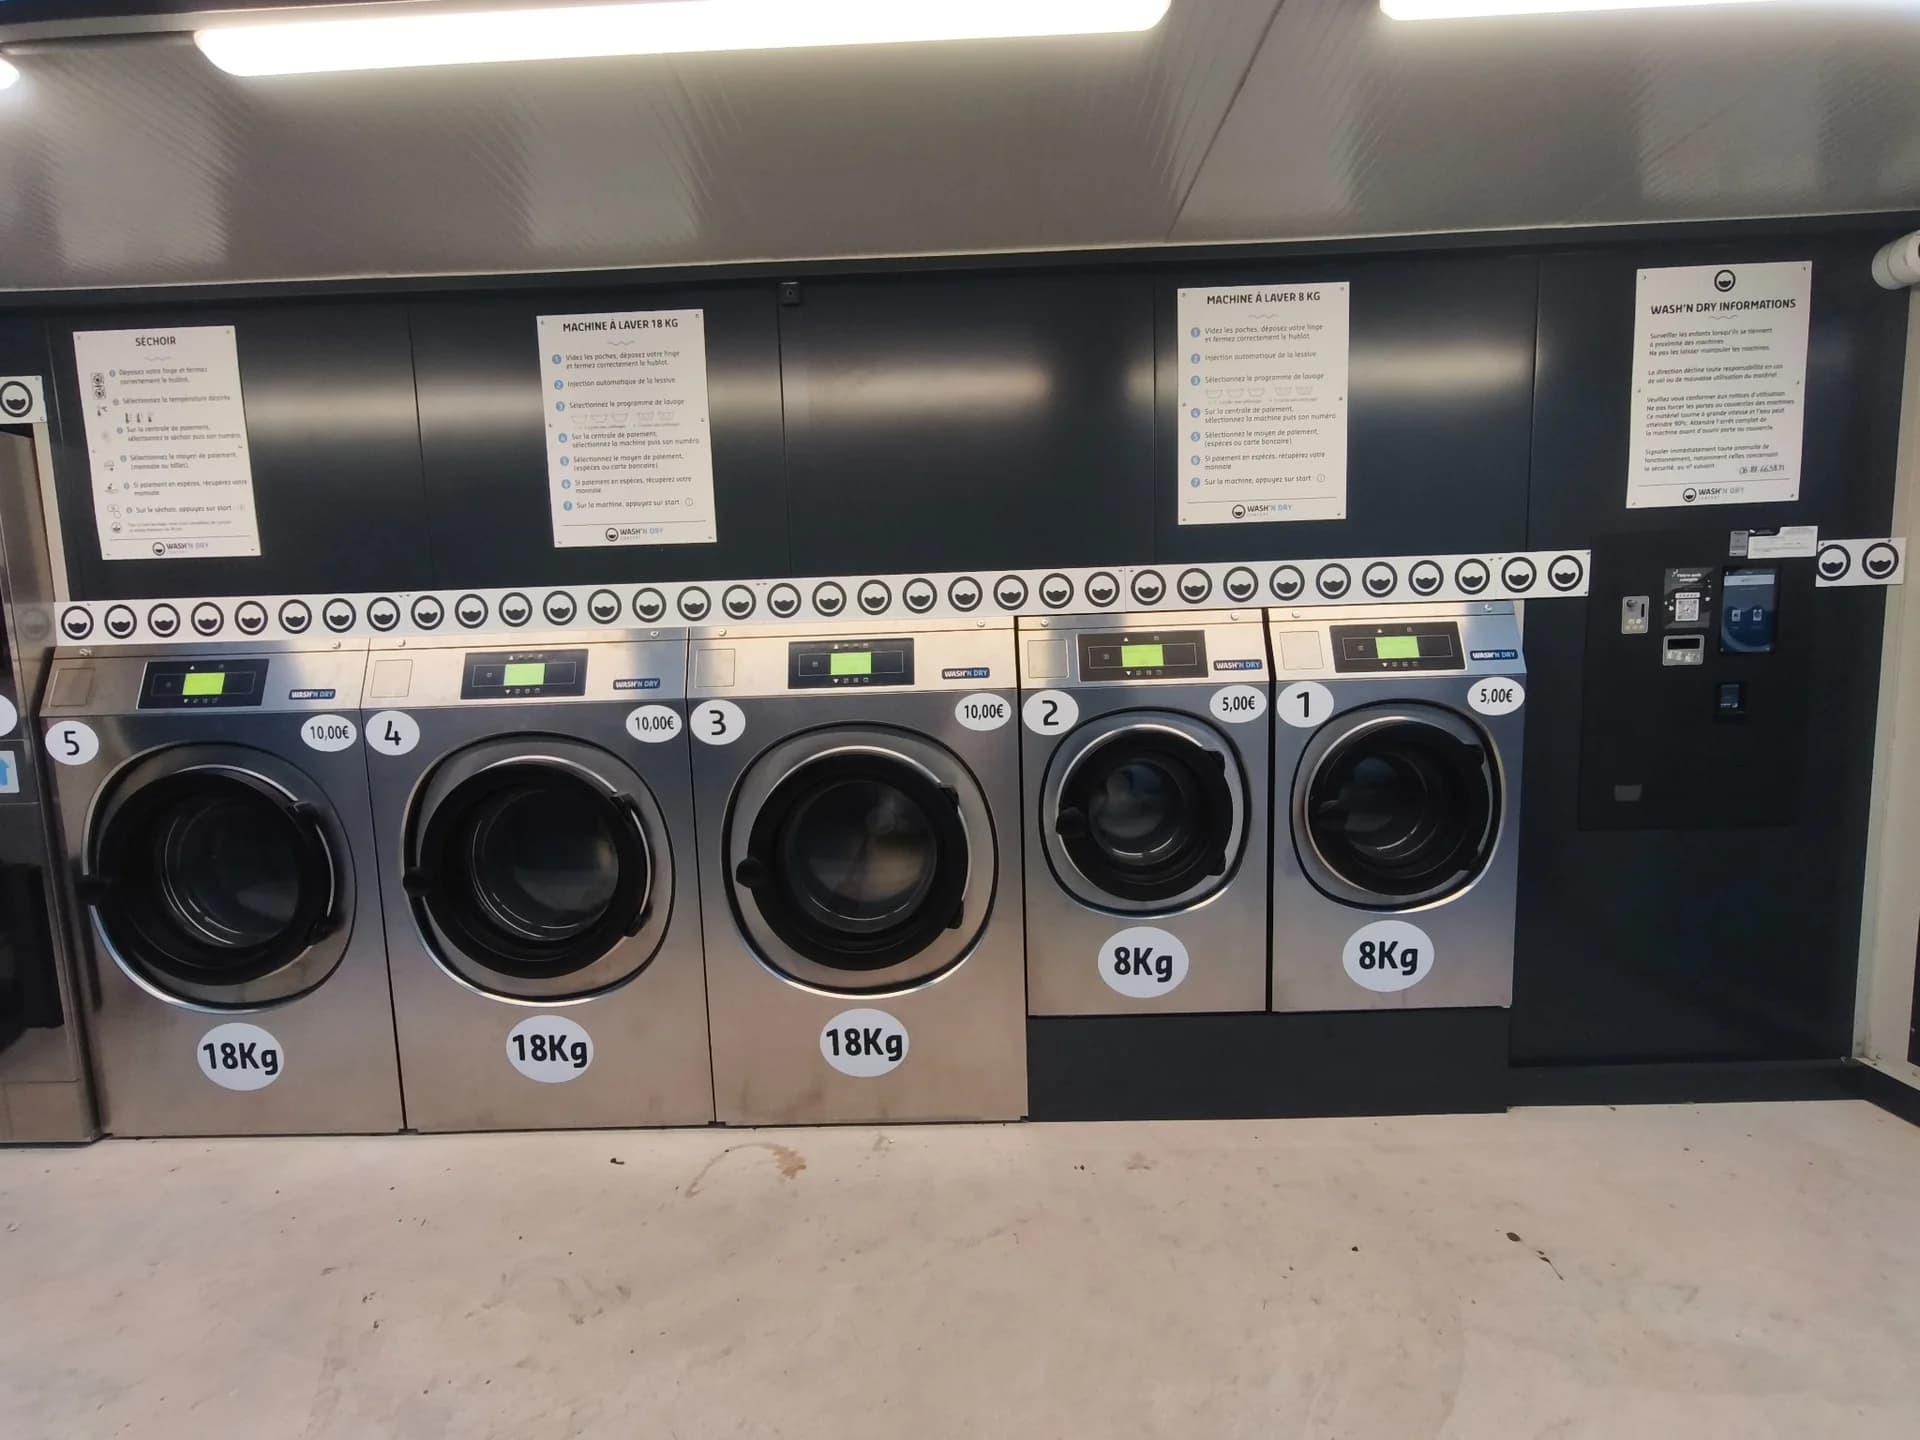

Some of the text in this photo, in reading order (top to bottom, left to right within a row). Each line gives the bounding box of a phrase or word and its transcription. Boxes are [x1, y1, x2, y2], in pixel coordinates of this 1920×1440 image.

[1206, 293, 1252, 305] MACHINE
[1265, 291, 1295, 302] LAVER
[1298, 291, 1304, 301] 8
[1306, 290, 1320, 301] KG
[1650, 298, 1796, 315] WASH'N DRY INFORMATIONS
[562, 320, 607, 332] MACHINE
[618, 318, 649, 330] LAVER
[651, 318, 662, 328] 18
[664, 317, 679, 328] KG
[1500, 650, 1516, 660] DRY
[973, 668, 989, 678] DRY
[1245, 660, 1262, 670] DRY
[644, 679, 660, 688] DRY
[319, 689, 335, 699] DRY
[1479, 688, 1514, 705] 5,00€
[963, 703, 1004, 720] 10,00€
[1041, 699, 1059, 726] 2
[1221, 695, 1256, 713] 5,00€
[1296, 691, 1311, 718] 1
[634, 715, 675, 732] 10,00€
[708, 709, 727, 736] 3
[309, 724, 350, 741] 10,00€
[384, 720, 402, 746] 4
[64, 730, 80, 756] 5
[1113, 947, 1173, 983] 8Kg
[1359, 940, 1419, 976] 8Kg
[511, 1034, 588, 1068] 18Kg
[825, 1027, 903, 1062] 18Kg
[202, 1042, 279, 1076] 18Kg
